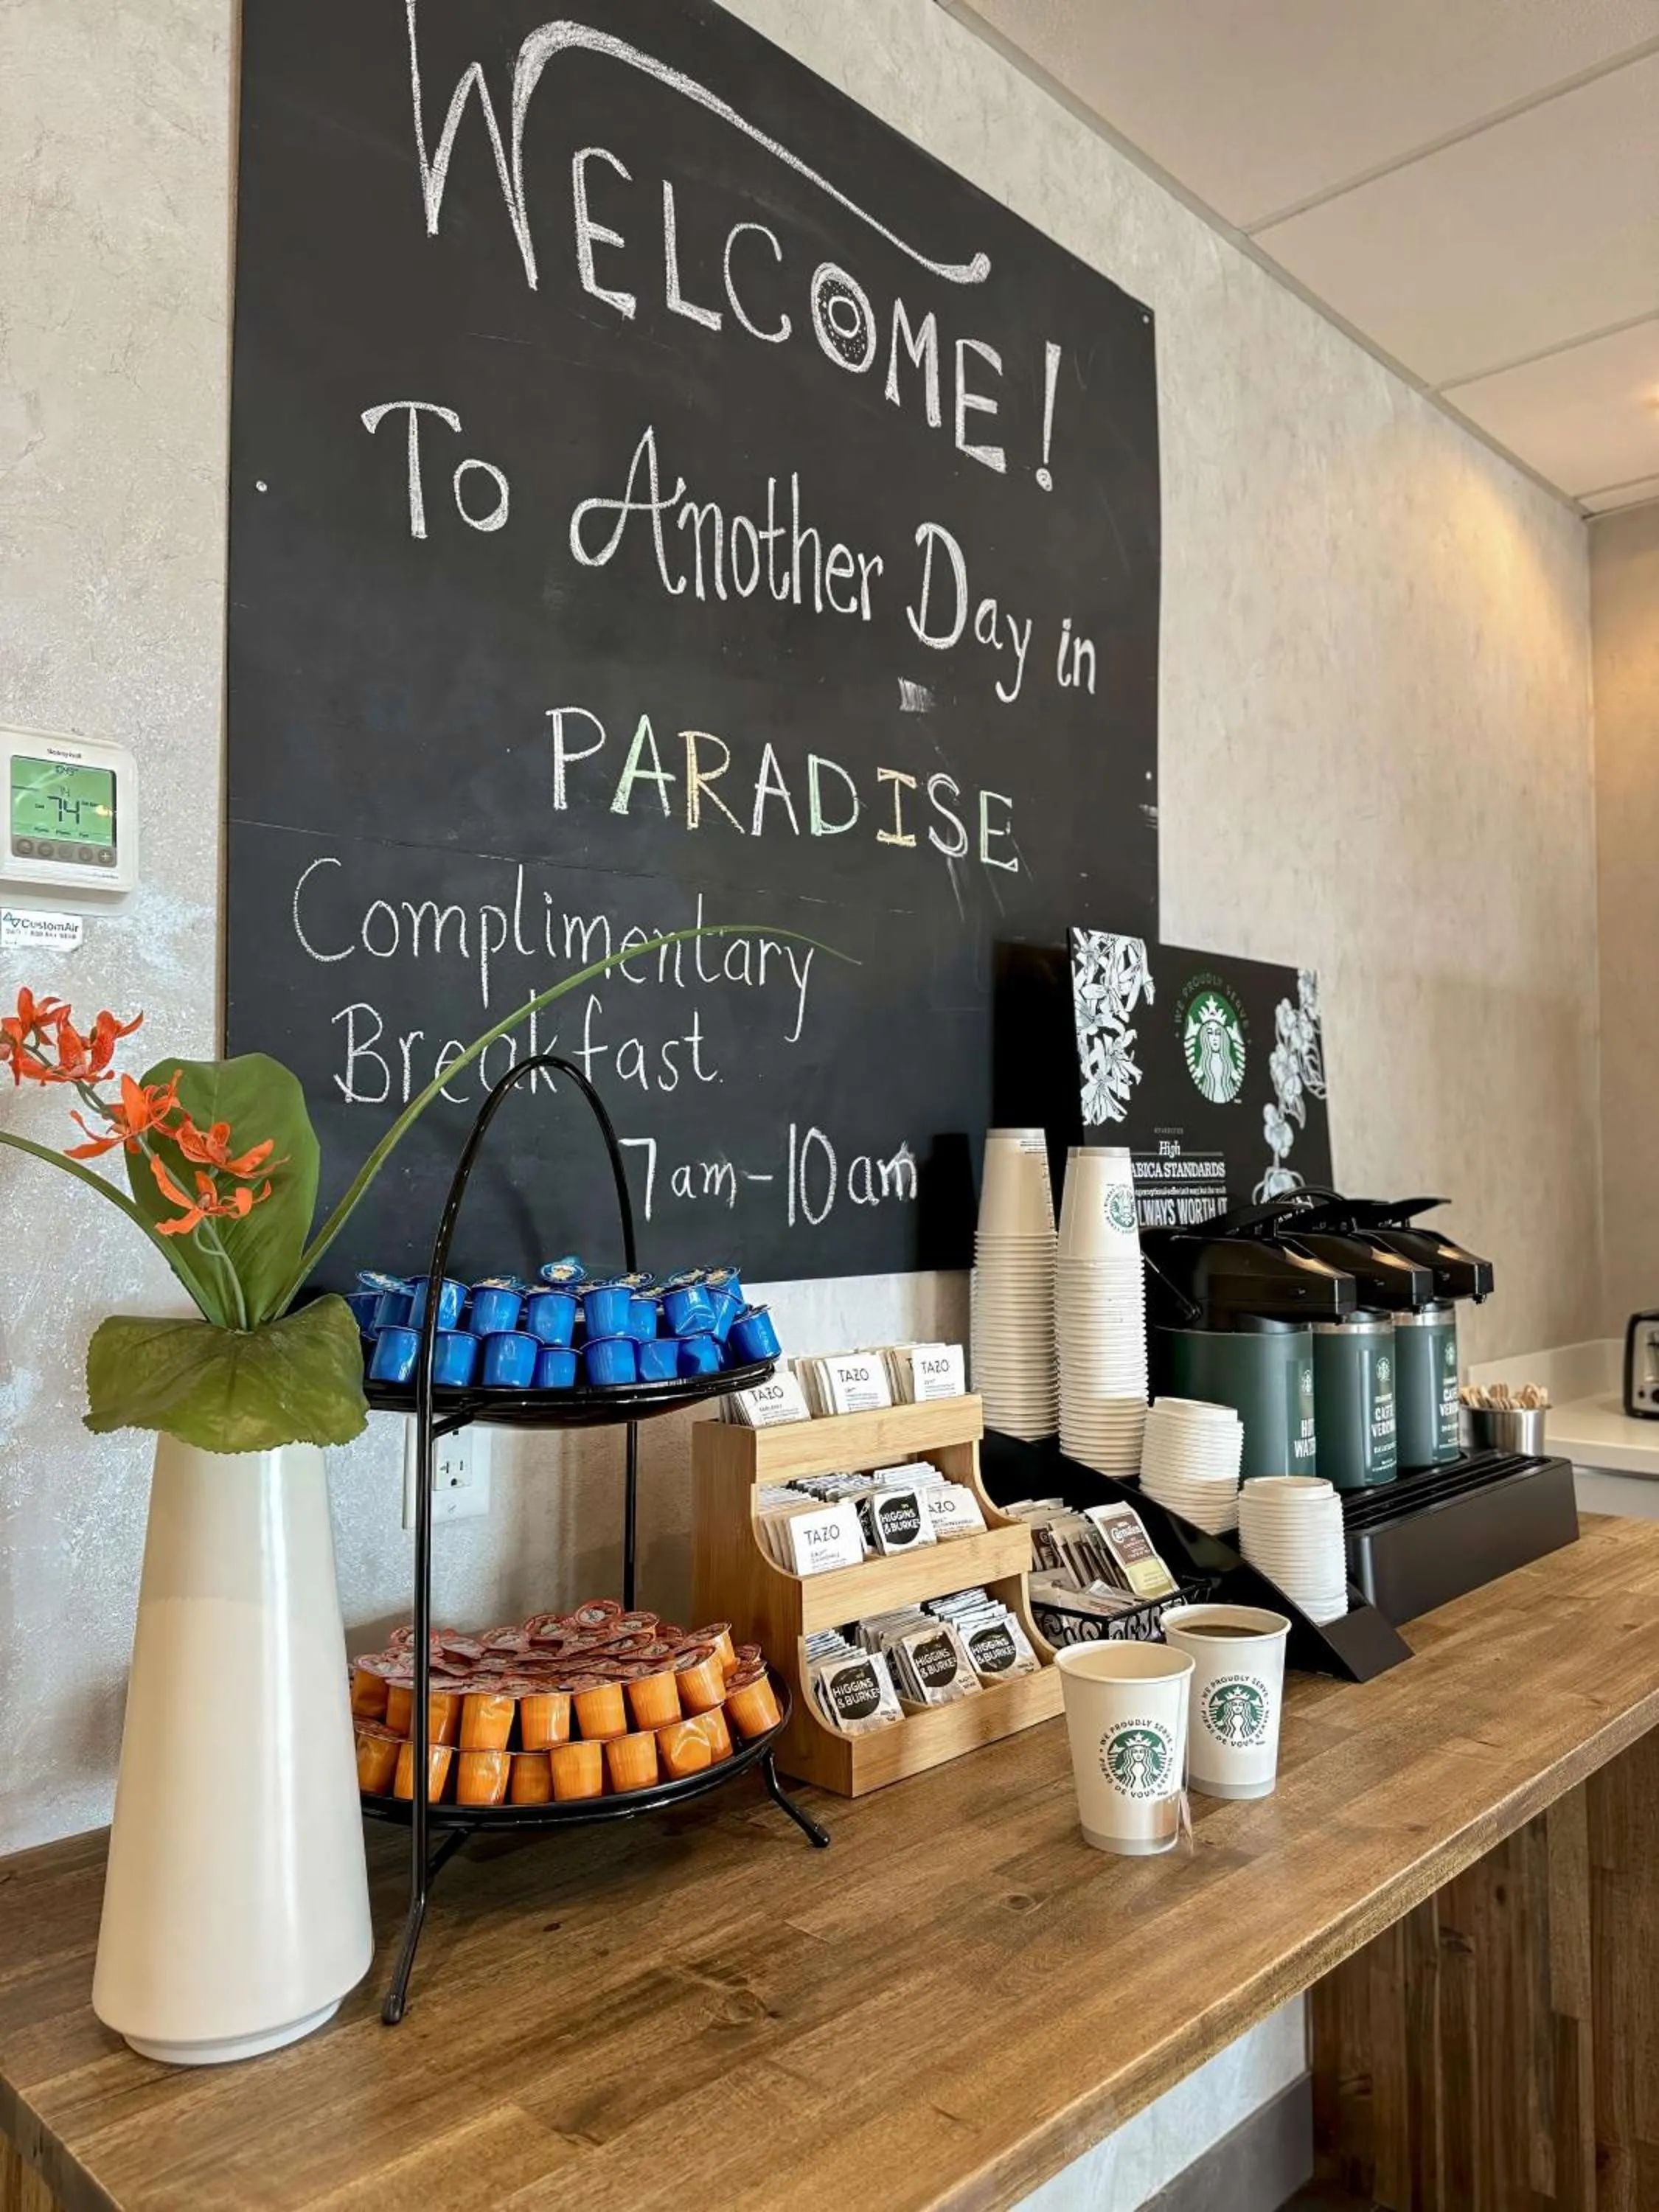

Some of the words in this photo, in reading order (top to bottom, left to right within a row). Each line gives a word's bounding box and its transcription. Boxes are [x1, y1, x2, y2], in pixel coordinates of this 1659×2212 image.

[361, 400, 509, 540] To
[568, 425, 884, 622] Another
[897, 521, 1032, 703] Day
[1057, 618, 1096, 695] in
[545, 706, 1019, 873] PARADISE
[47, 795, 80, 825] 74
[293, 857, 815, 1043] Complimentary
[1158, 1139, 1180, 1158] High
[1131, 1161, 1163, 1178] ABICA
[1163, 1161, 1226, 1178] STANDARDS
[1136, 1198, 1176, 1226] LWAYS
[1177, 1197, 1217, 1225] WORTH
[920, 1358, 950, 1374] TAZO
[838, 1368, 869, 1382] TAZO
[750, 1385, 784, 1402] TAZO
[928, 1500, 956, 1514] AZO
[880, 1509, 917, 1523] HIGGINS
[803, 1524, 840, 1545] TAZO
[971, 1638, 1009, 1655] HIGGINS
[914, 1648, 951, 1666] HIGGINS
[832, 1677, 874, 1697] HIGGINS
[1210, 1674, 1250, 1688] PROUDLY
[1110, 1719, 1152, 1733] PROUDLY
[1130, 1788, 1155, 1798] VOUS
